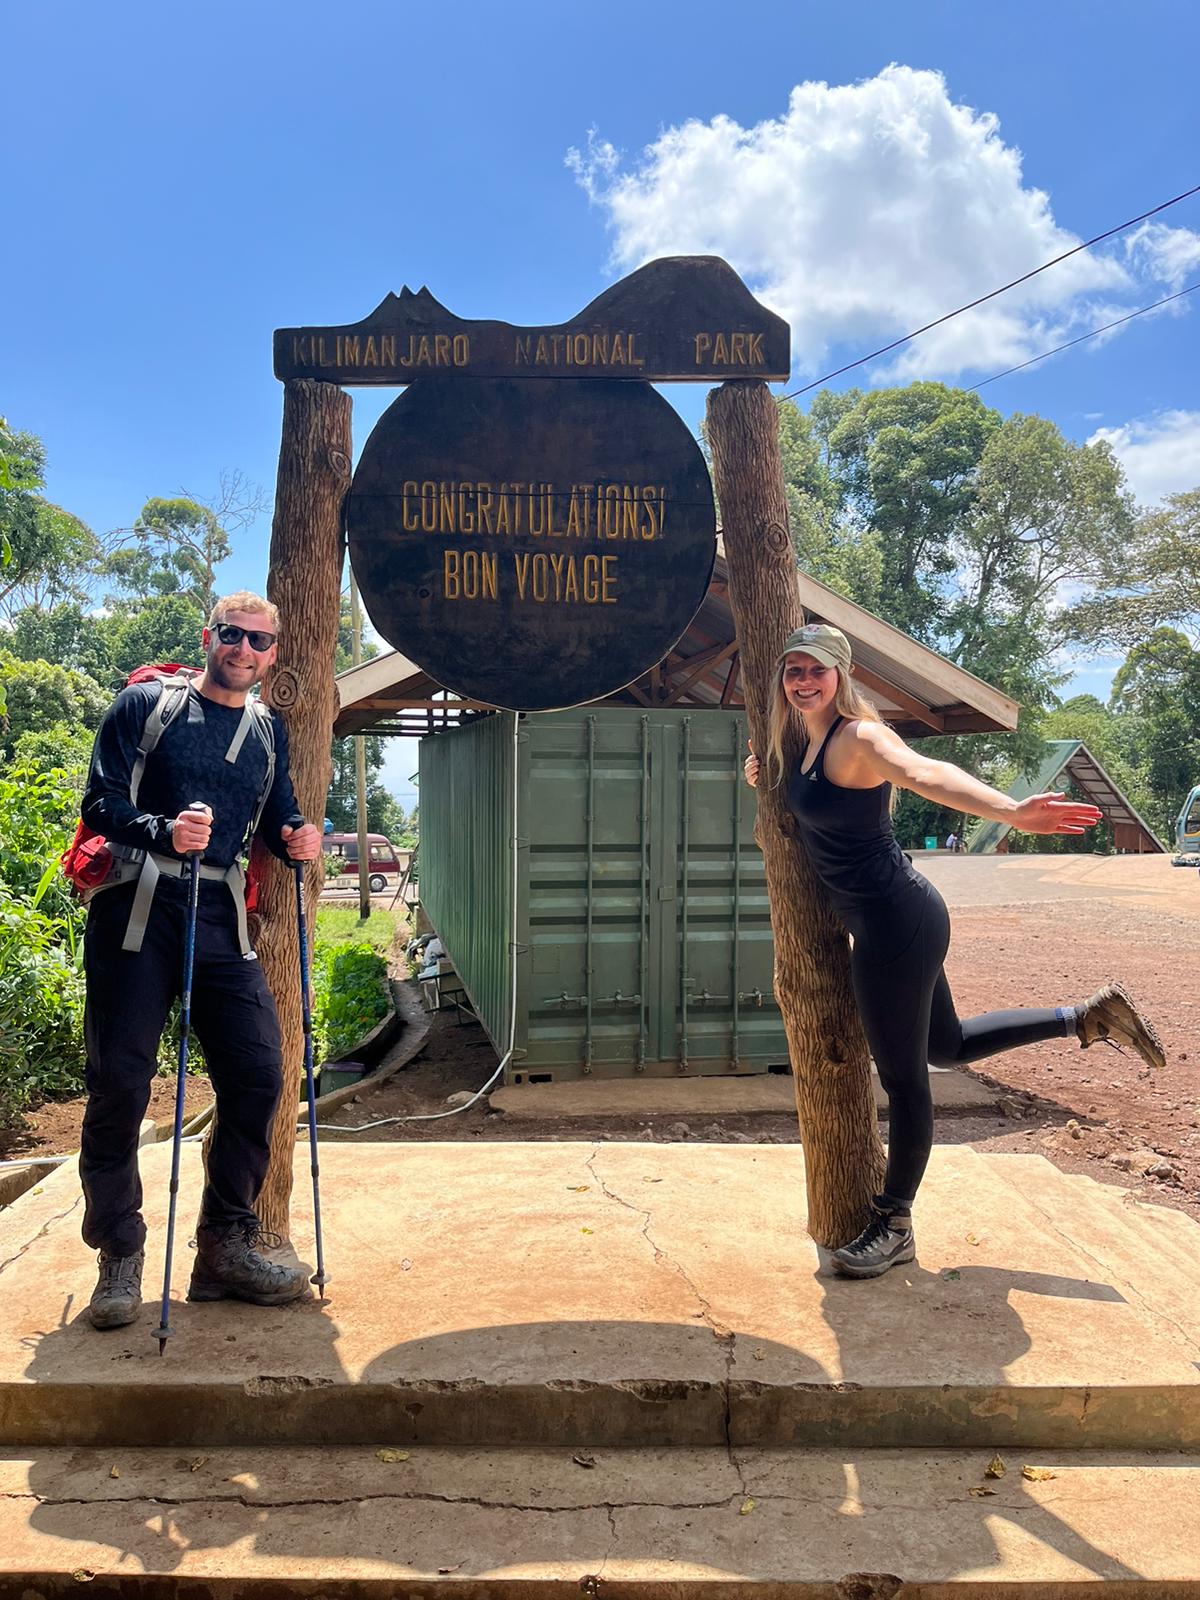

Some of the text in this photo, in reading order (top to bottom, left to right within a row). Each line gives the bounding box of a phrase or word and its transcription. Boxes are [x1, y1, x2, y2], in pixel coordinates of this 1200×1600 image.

[292, 332, 766, 367] KILIMANJARO NATIONAL PARK
[402, 480, 666, 541] CONGRATULATIONS!
[443, 550, 618, 603] BON VOYAGE
